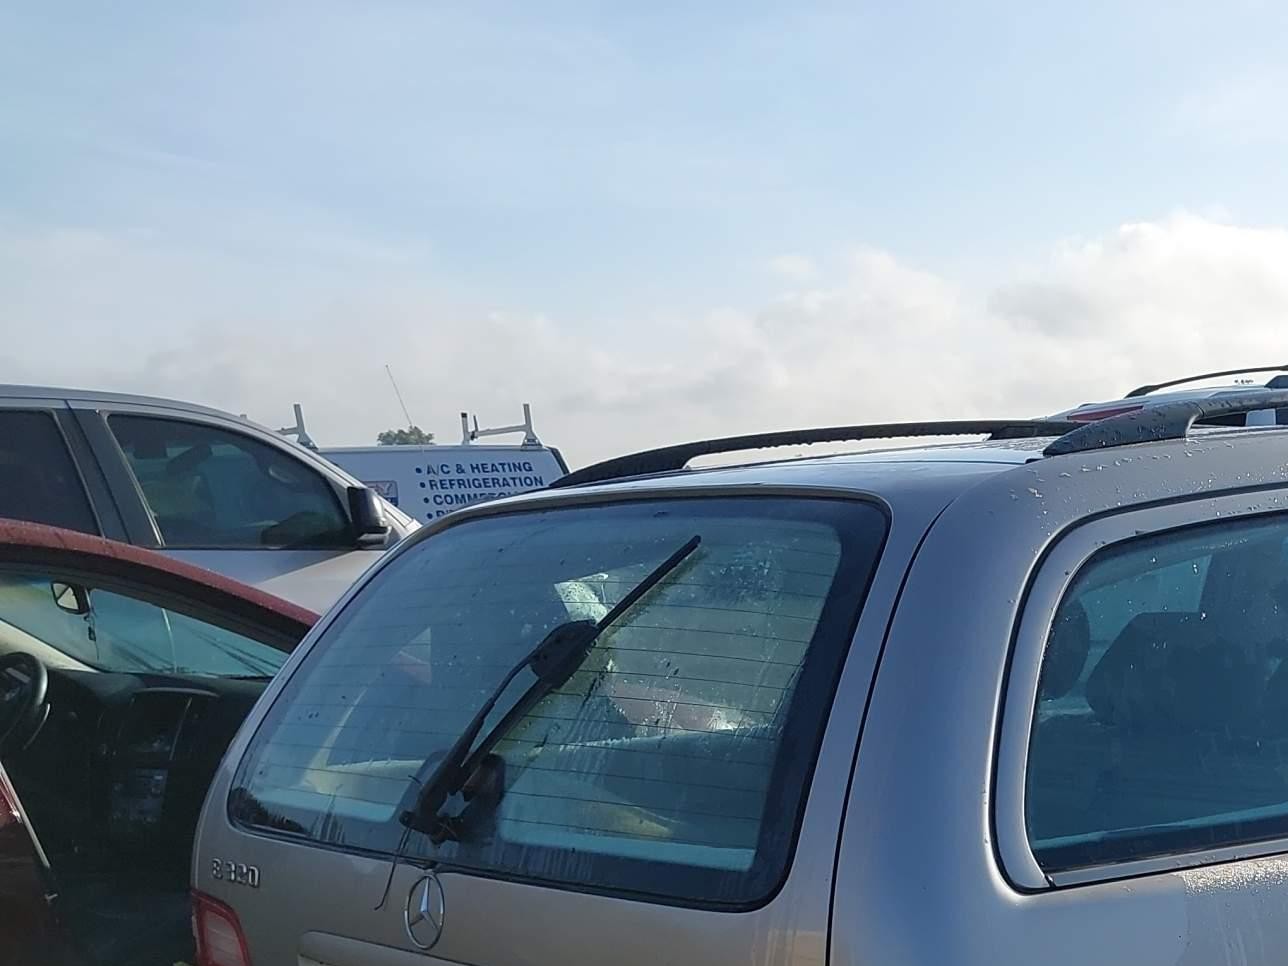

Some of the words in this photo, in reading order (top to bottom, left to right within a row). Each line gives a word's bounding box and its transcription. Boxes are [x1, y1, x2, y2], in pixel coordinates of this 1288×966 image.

[426, 463, 451, 476] A/C
[455, 463, 466, 474] &
[470, 461, 533, 474] HEATING
[429, 476, 544, 491] REFRIGERATION
